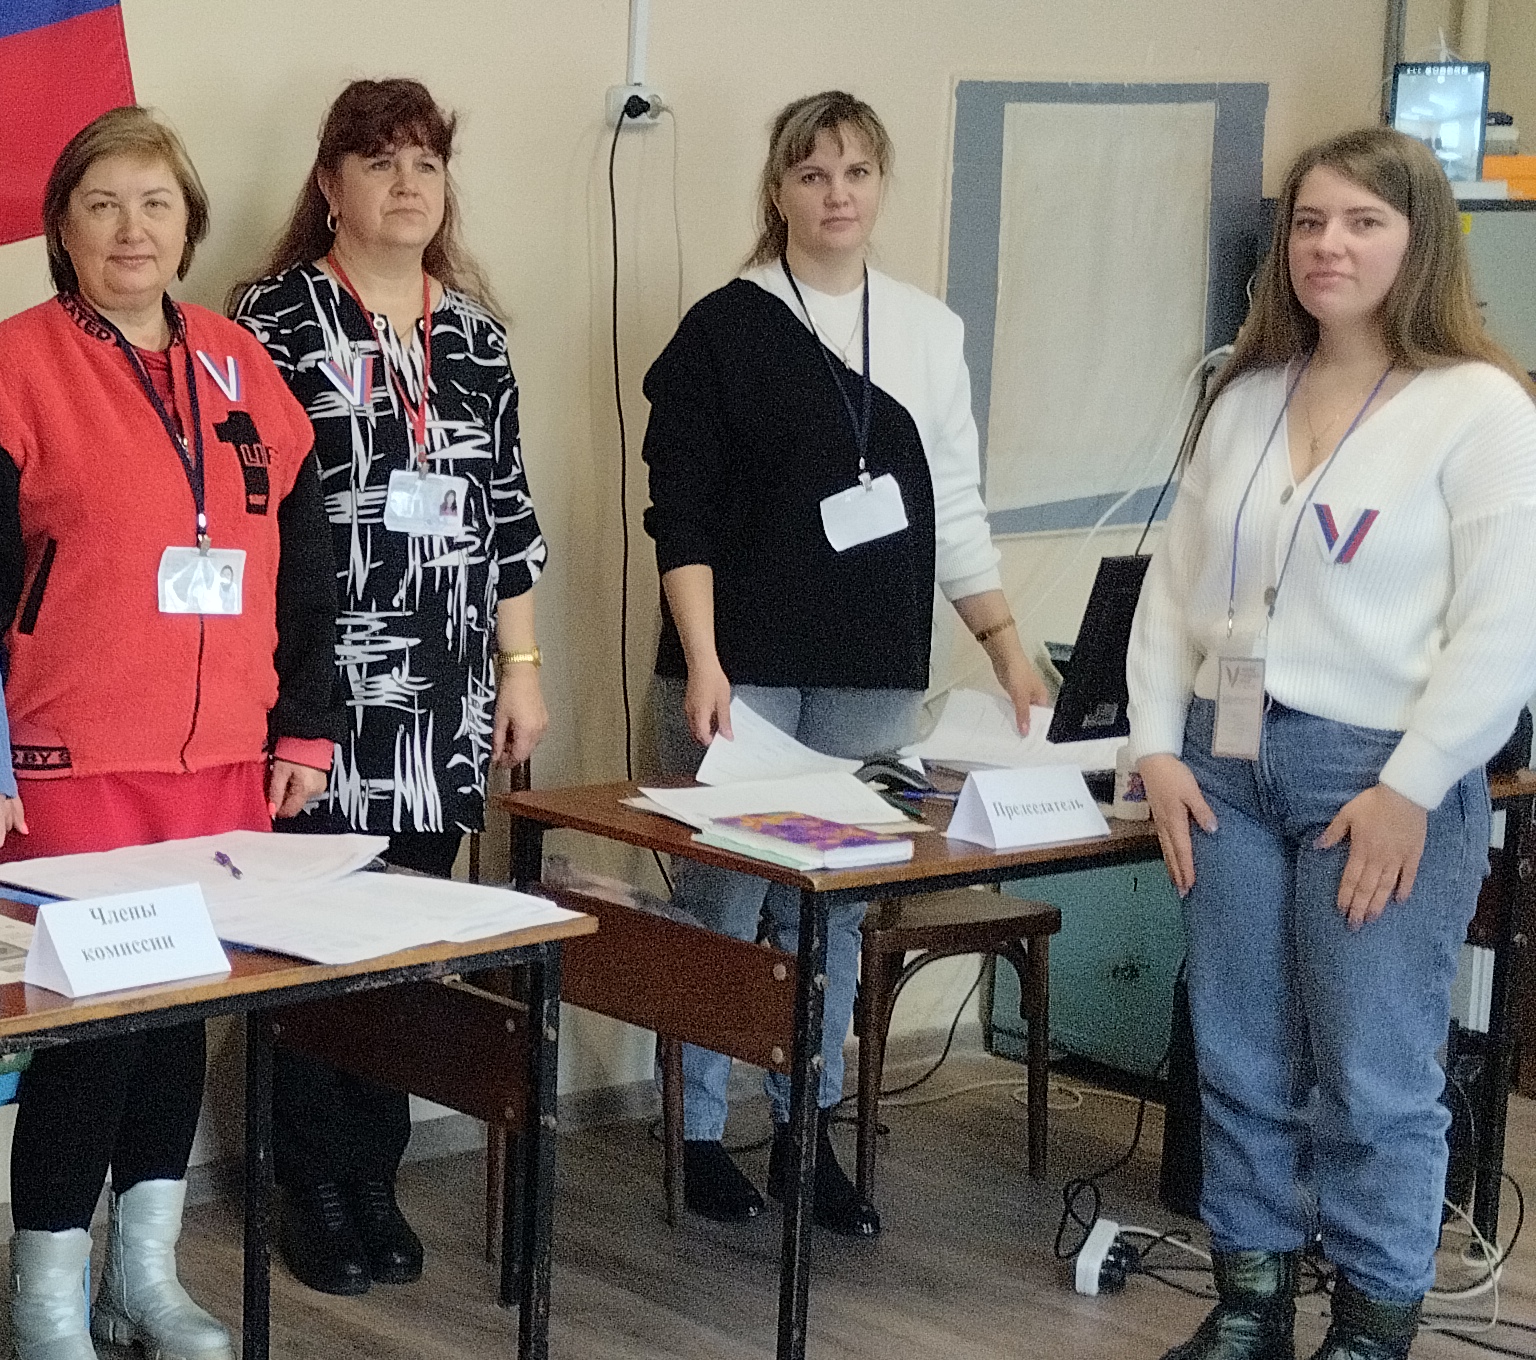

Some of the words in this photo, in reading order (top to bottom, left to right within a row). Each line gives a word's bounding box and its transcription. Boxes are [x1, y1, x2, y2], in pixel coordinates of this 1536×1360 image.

[992, 799, 1084, 821] Председатель
[88, 902, 157, 926] Члены
[80, 934, 176, 963] комиссии
